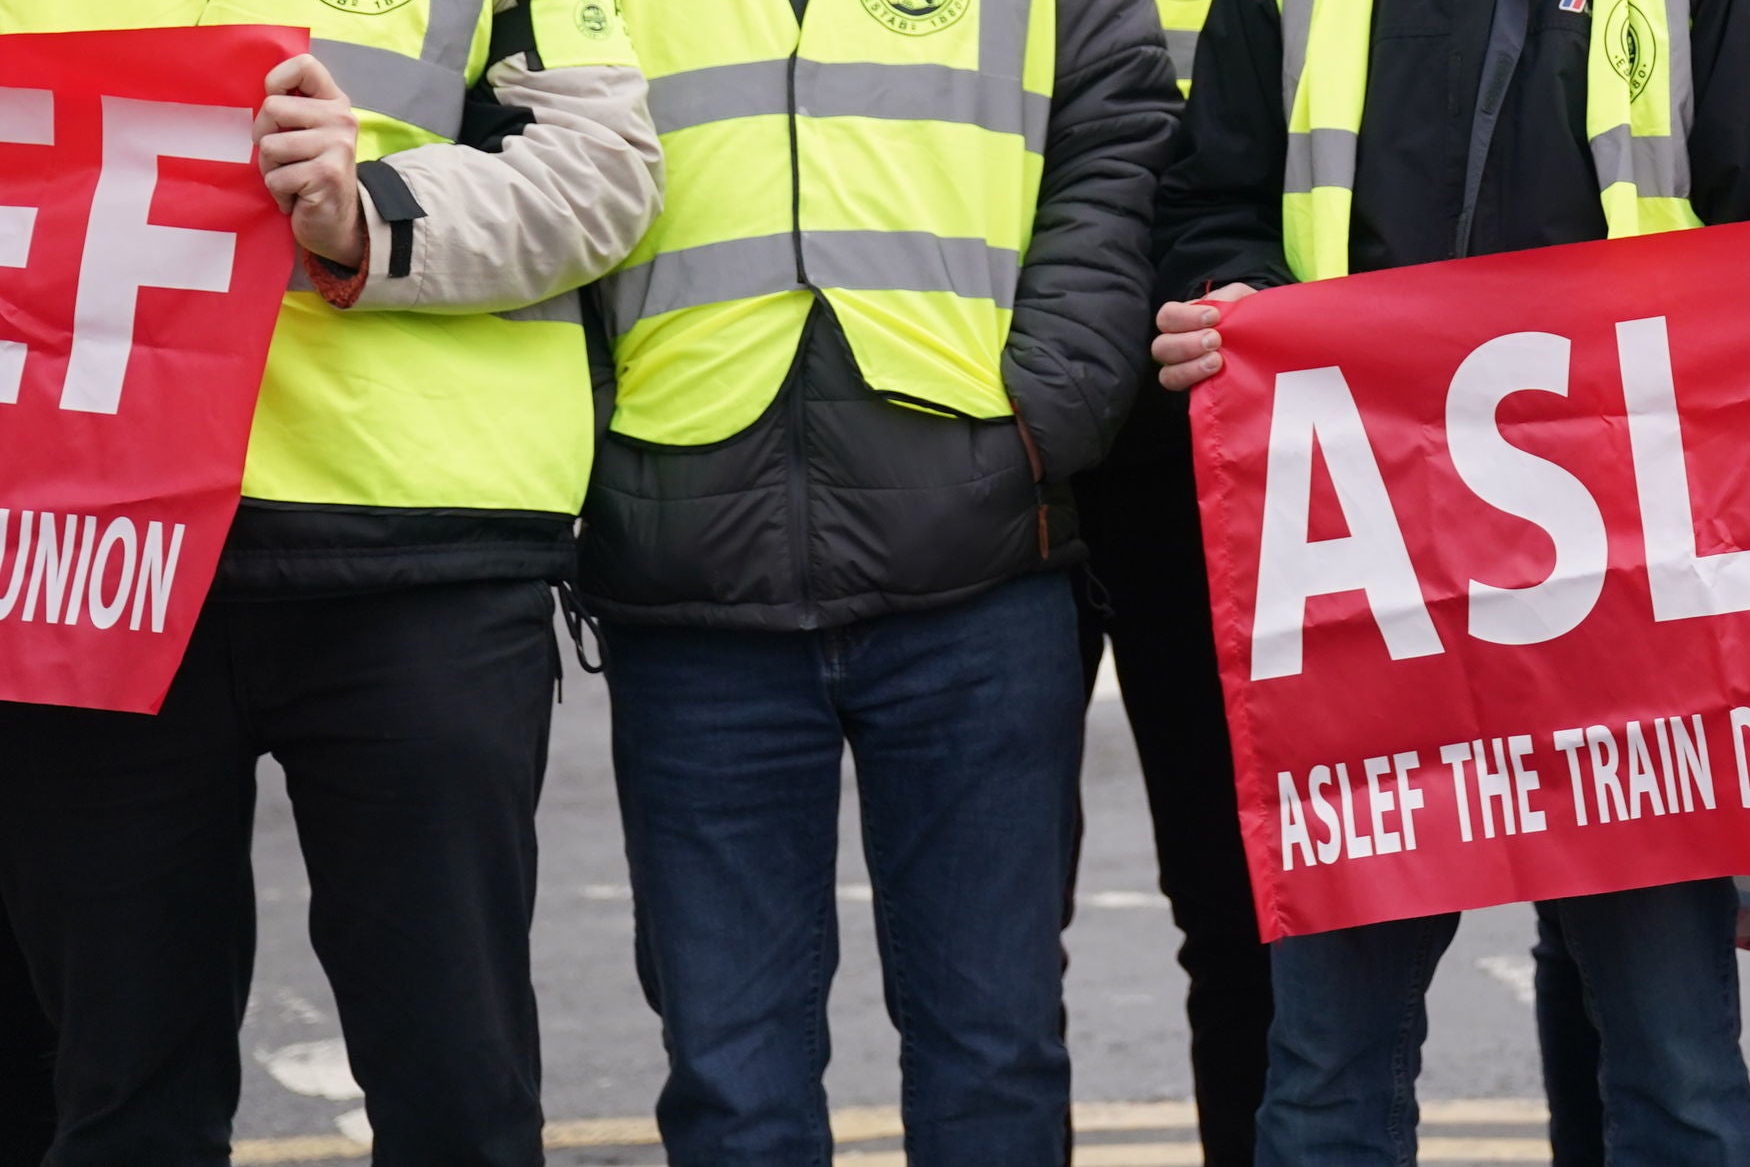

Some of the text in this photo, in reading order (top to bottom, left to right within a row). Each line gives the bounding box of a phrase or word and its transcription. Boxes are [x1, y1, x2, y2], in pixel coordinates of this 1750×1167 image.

[0, 507, 187, 634] UNION
[1277, 750, 1425, 872] ASLEF
[1440, 734, 1548, 843] THE
[1553, 713, 1717, 827] TRAIN
